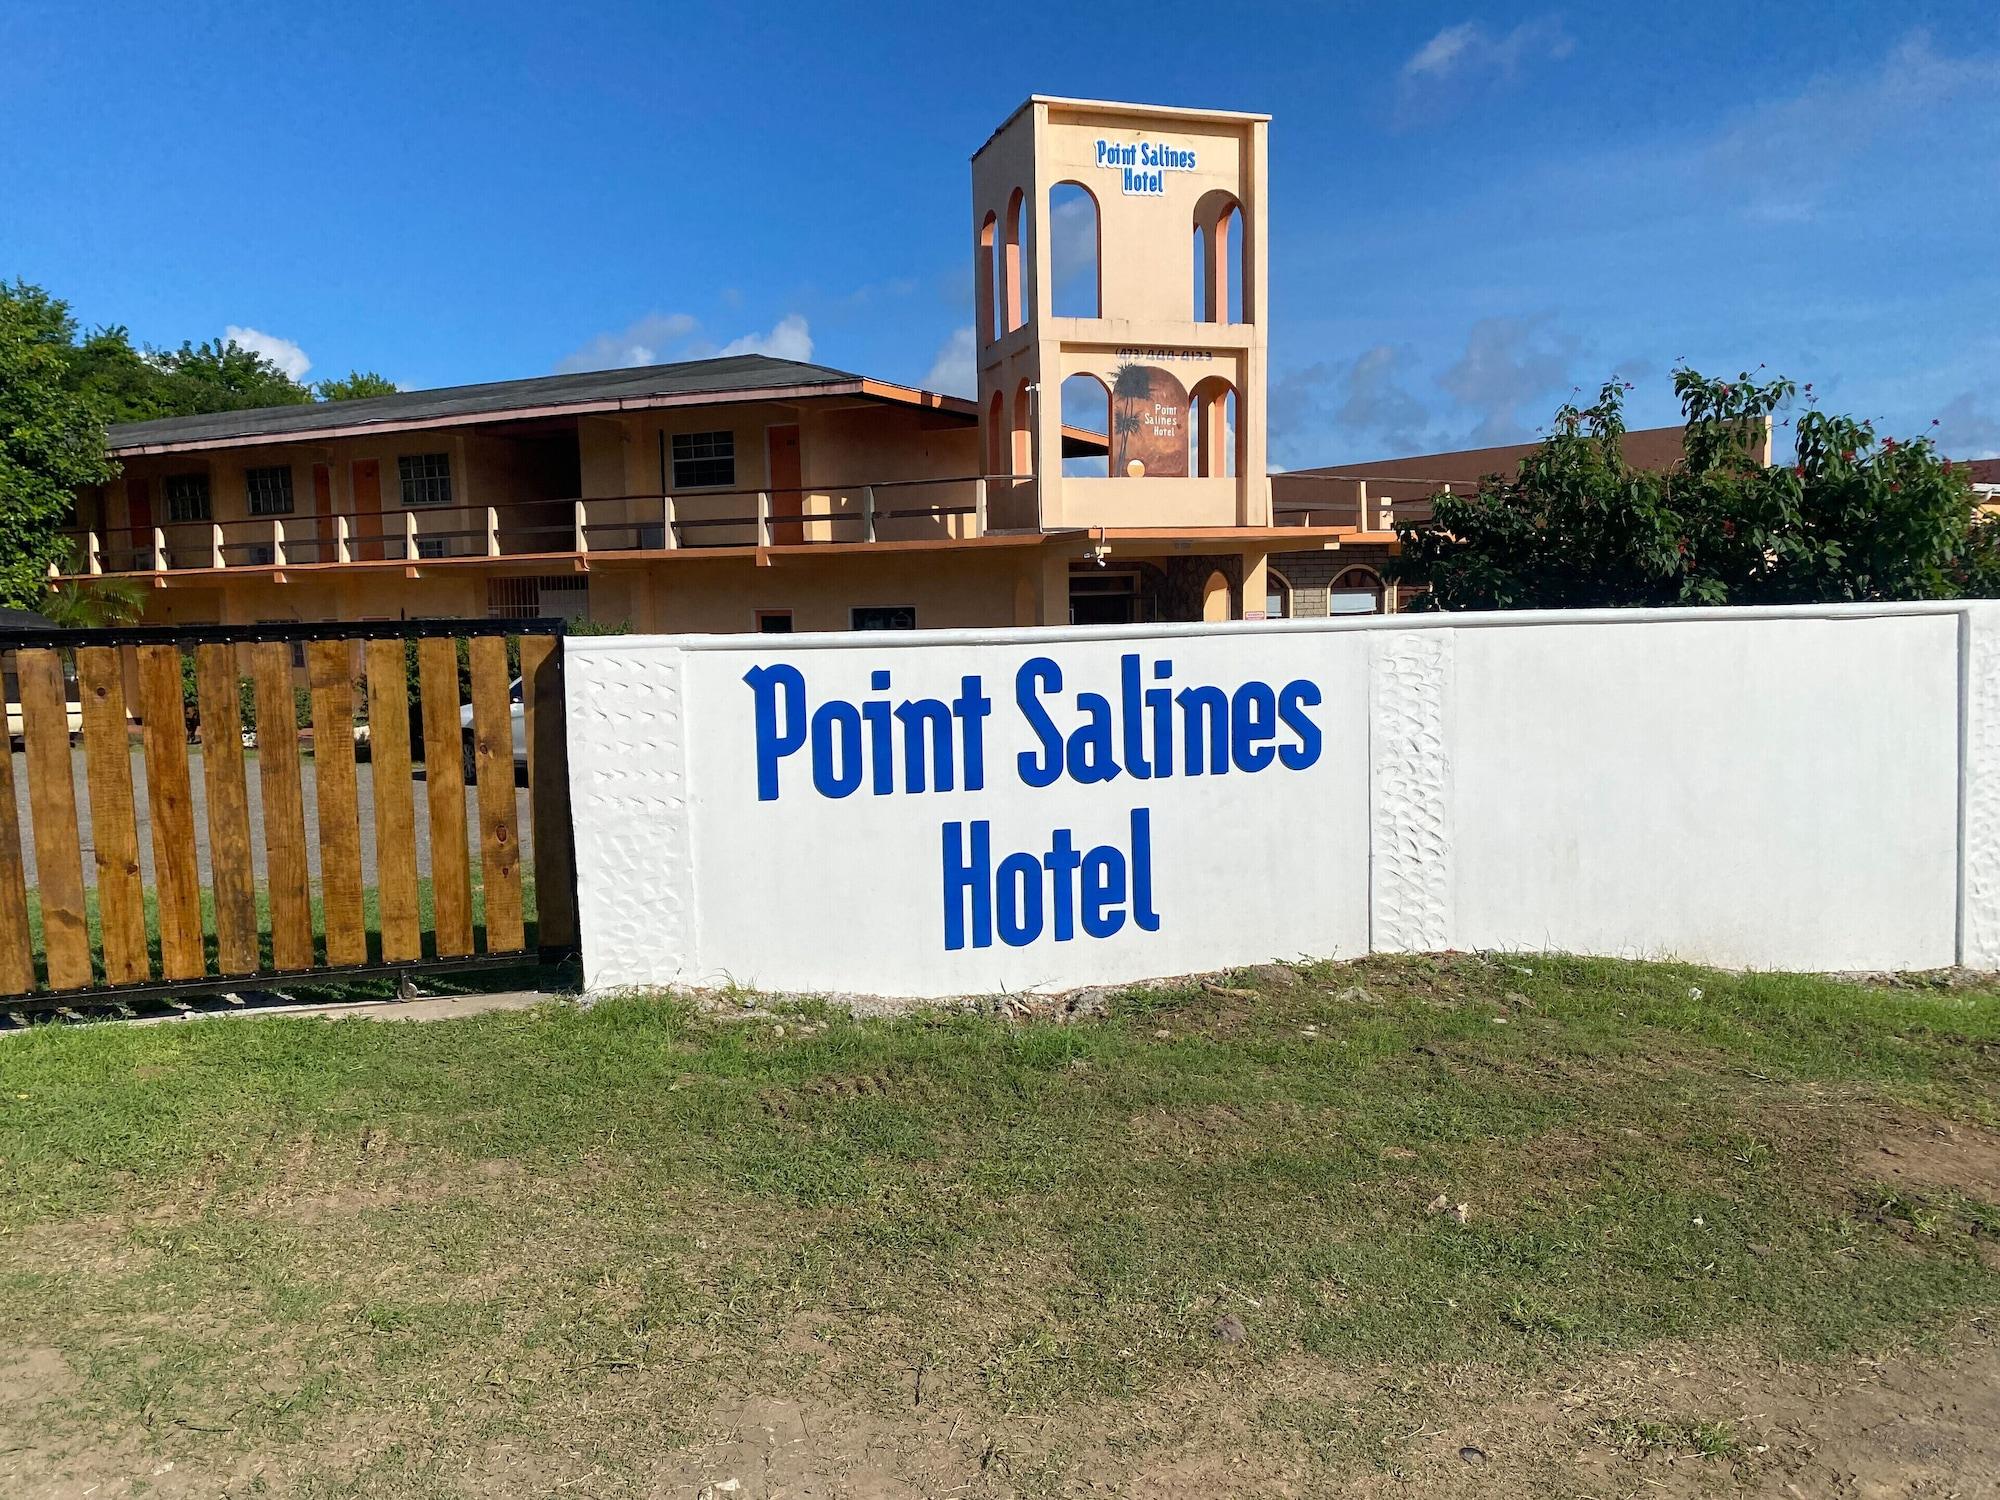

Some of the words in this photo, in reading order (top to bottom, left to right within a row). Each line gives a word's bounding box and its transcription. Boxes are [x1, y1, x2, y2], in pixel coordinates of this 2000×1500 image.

[1097, 140, 1136, 165] Point
[1141, 143, 1195, 168] Salines
[1124, 168, 1163, 192] Hotel
[1144, 413, 1177, 426] Salines
[1155, 404, 1177, 415] Point
[1154, 426, 1175, 437] Hotel
[743, 663, 991, 800] Point
[1016, 654, 1322, 788] Salines
[942, 807, 1160, 950] Hotel
